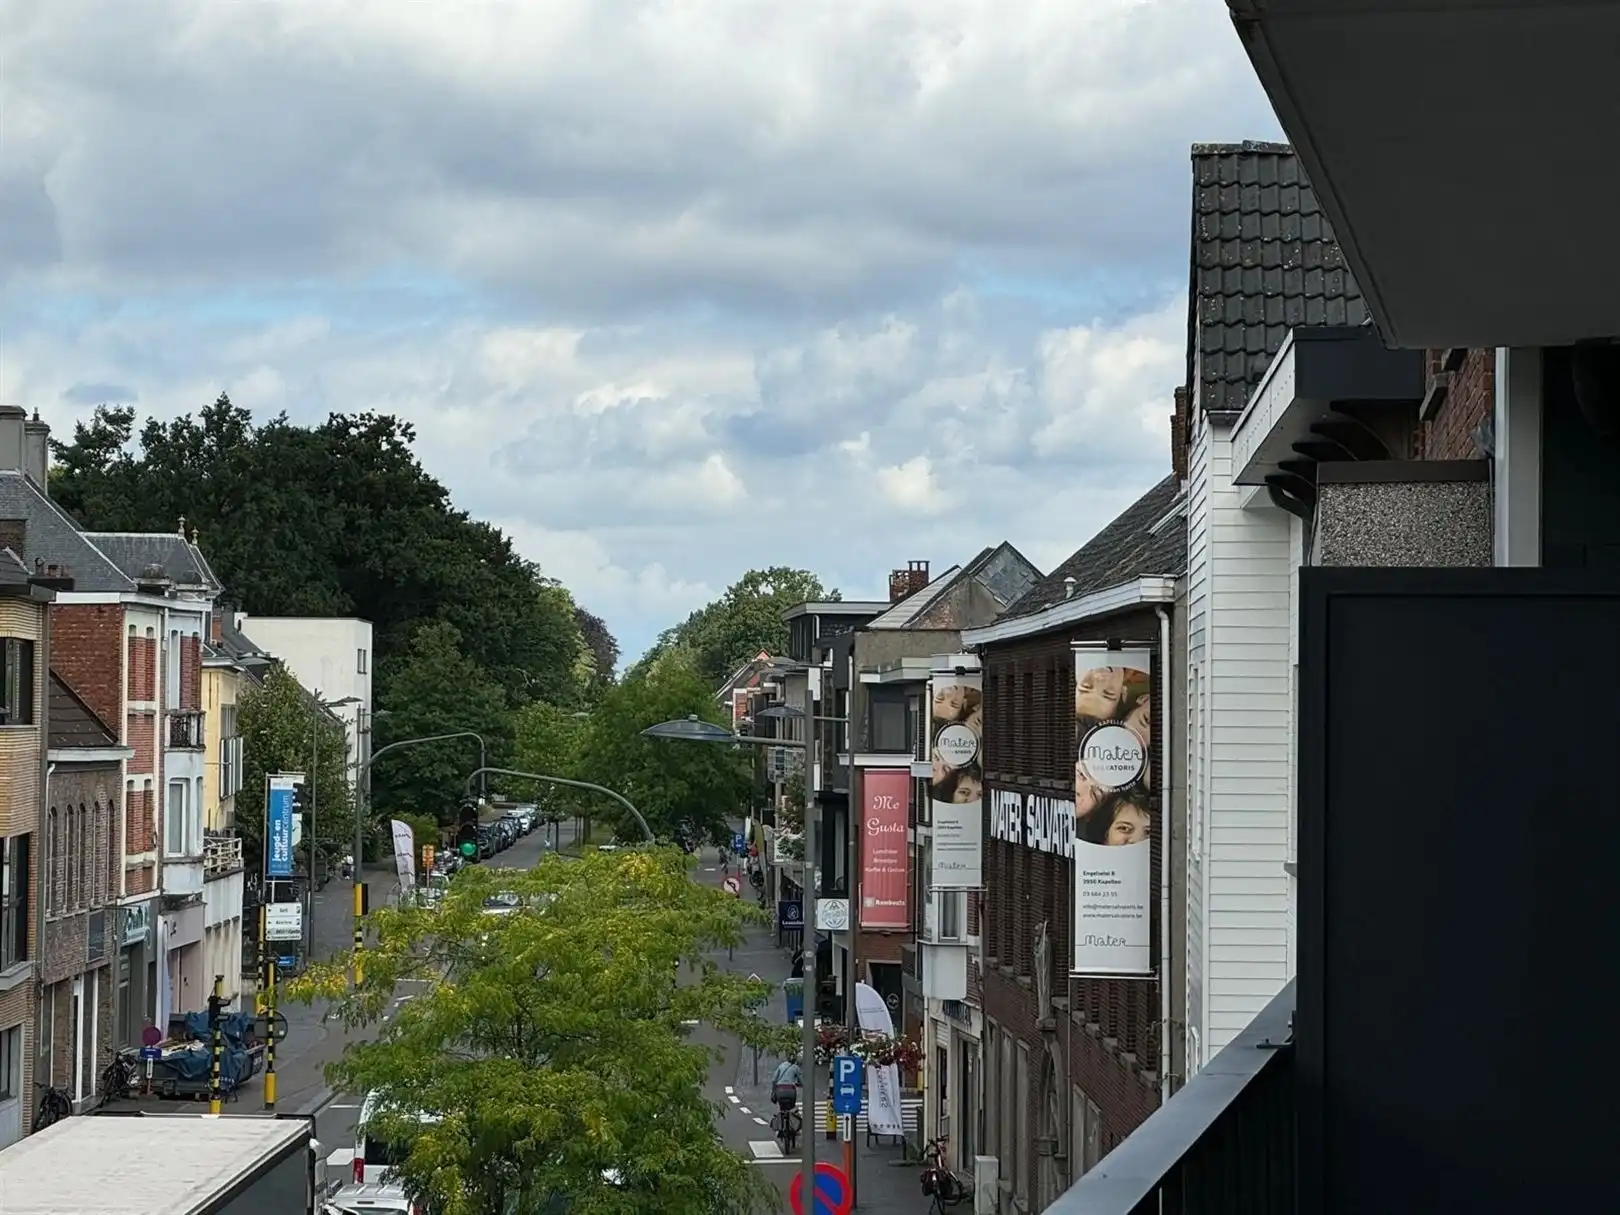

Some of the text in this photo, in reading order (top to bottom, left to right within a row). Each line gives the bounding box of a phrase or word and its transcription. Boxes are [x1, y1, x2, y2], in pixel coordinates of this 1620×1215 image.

[1087, 745, 1142, 761] Mater
[873, 795, 900, 810] Me
[274, 819, 281, 831] en
[991, 788, 1022, 845] MATER
[279, 794, 290, 862] cultuurcentrum
[867, 817, 904, 836] Gusta
[1085, 935, 1127, 947] Mater
[840, 1060, 855, 1082] P
